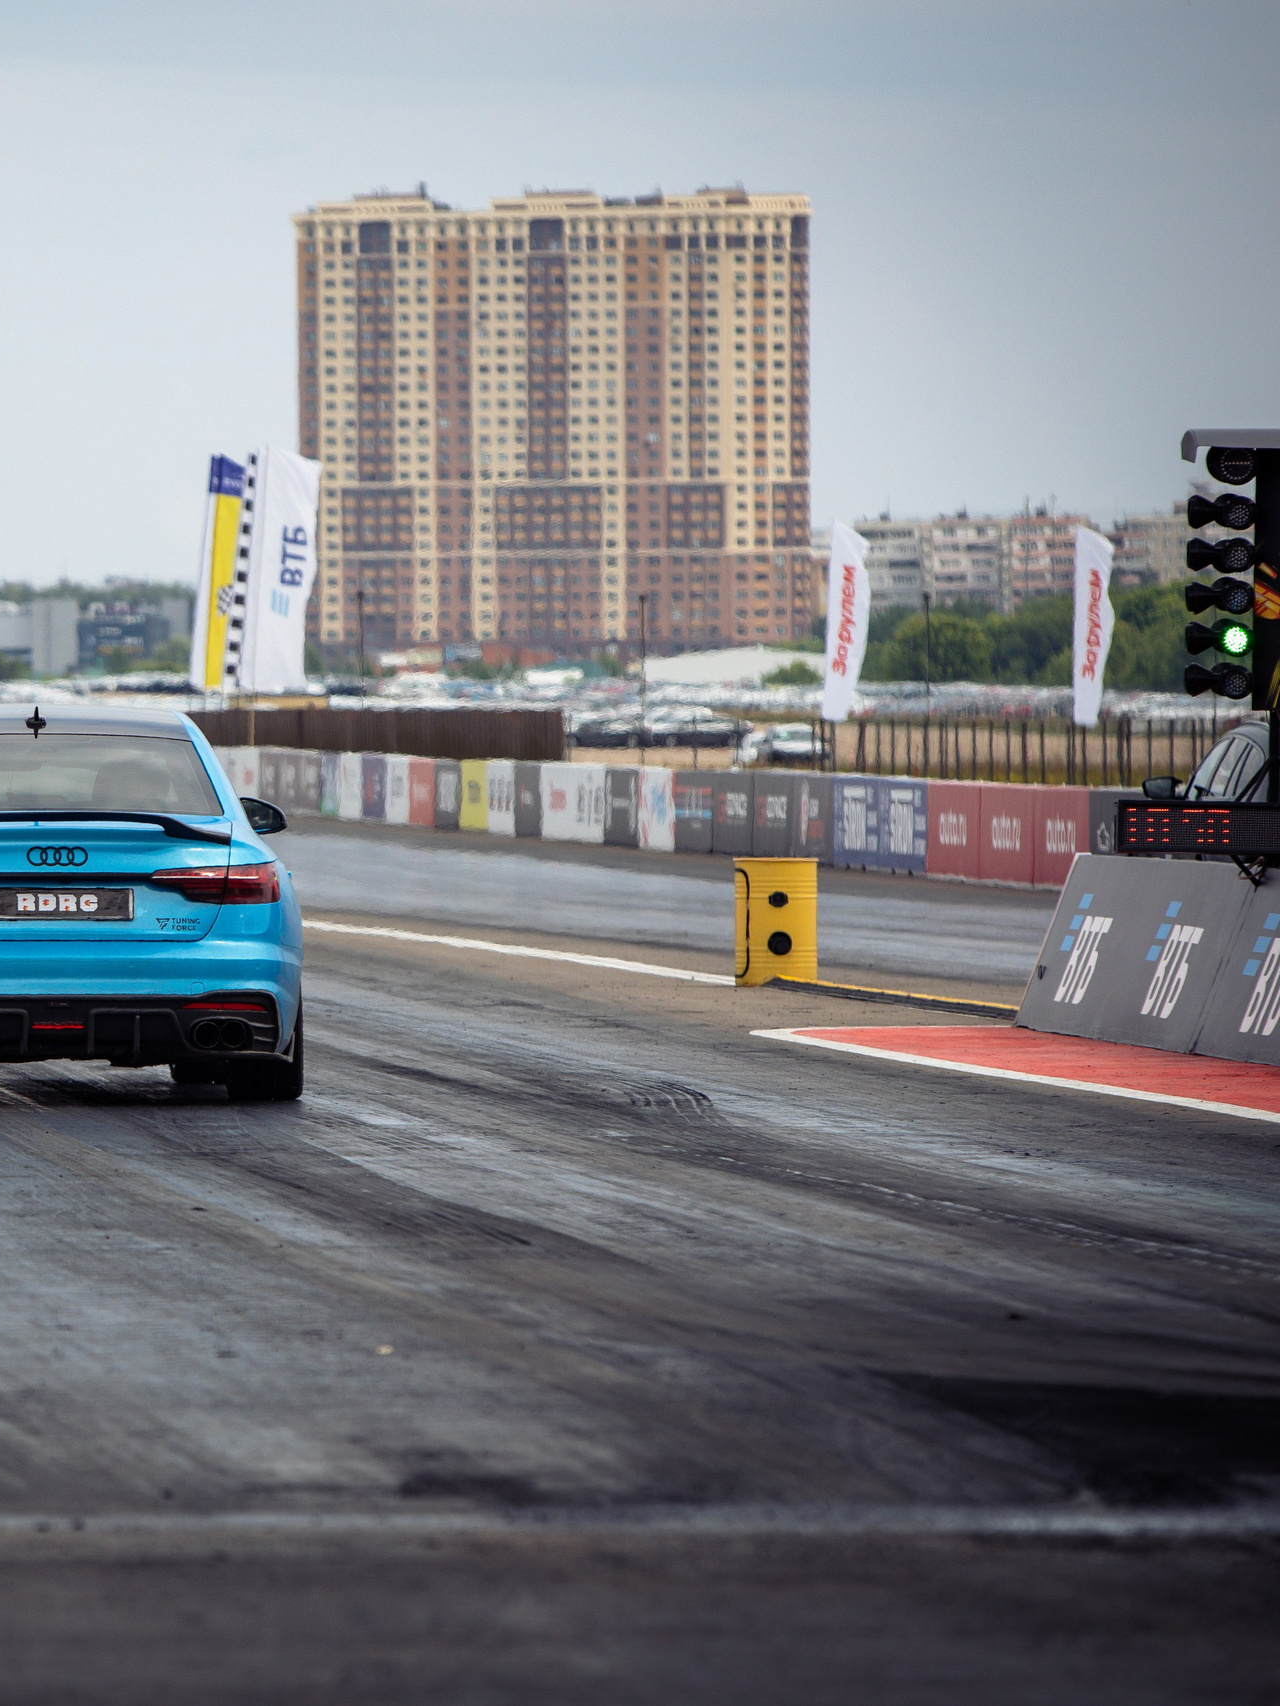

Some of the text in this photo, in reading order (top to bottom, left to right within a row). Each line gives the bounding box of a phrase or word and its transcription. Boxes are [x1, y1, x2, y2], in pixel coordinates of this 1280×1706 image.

[280, 525, 308, 588] ВТБ
[939, 809, 967, 847] auto.ru
[992, 811, 1021, 851] auto.ru
[1046, 813, 1076, 853] auto.ru
[16, 893, 98, 912] RDRC
[1053, 915, 1114, 1005] ВТБ
[1140, 924, 1205, 1019] ВТБ
